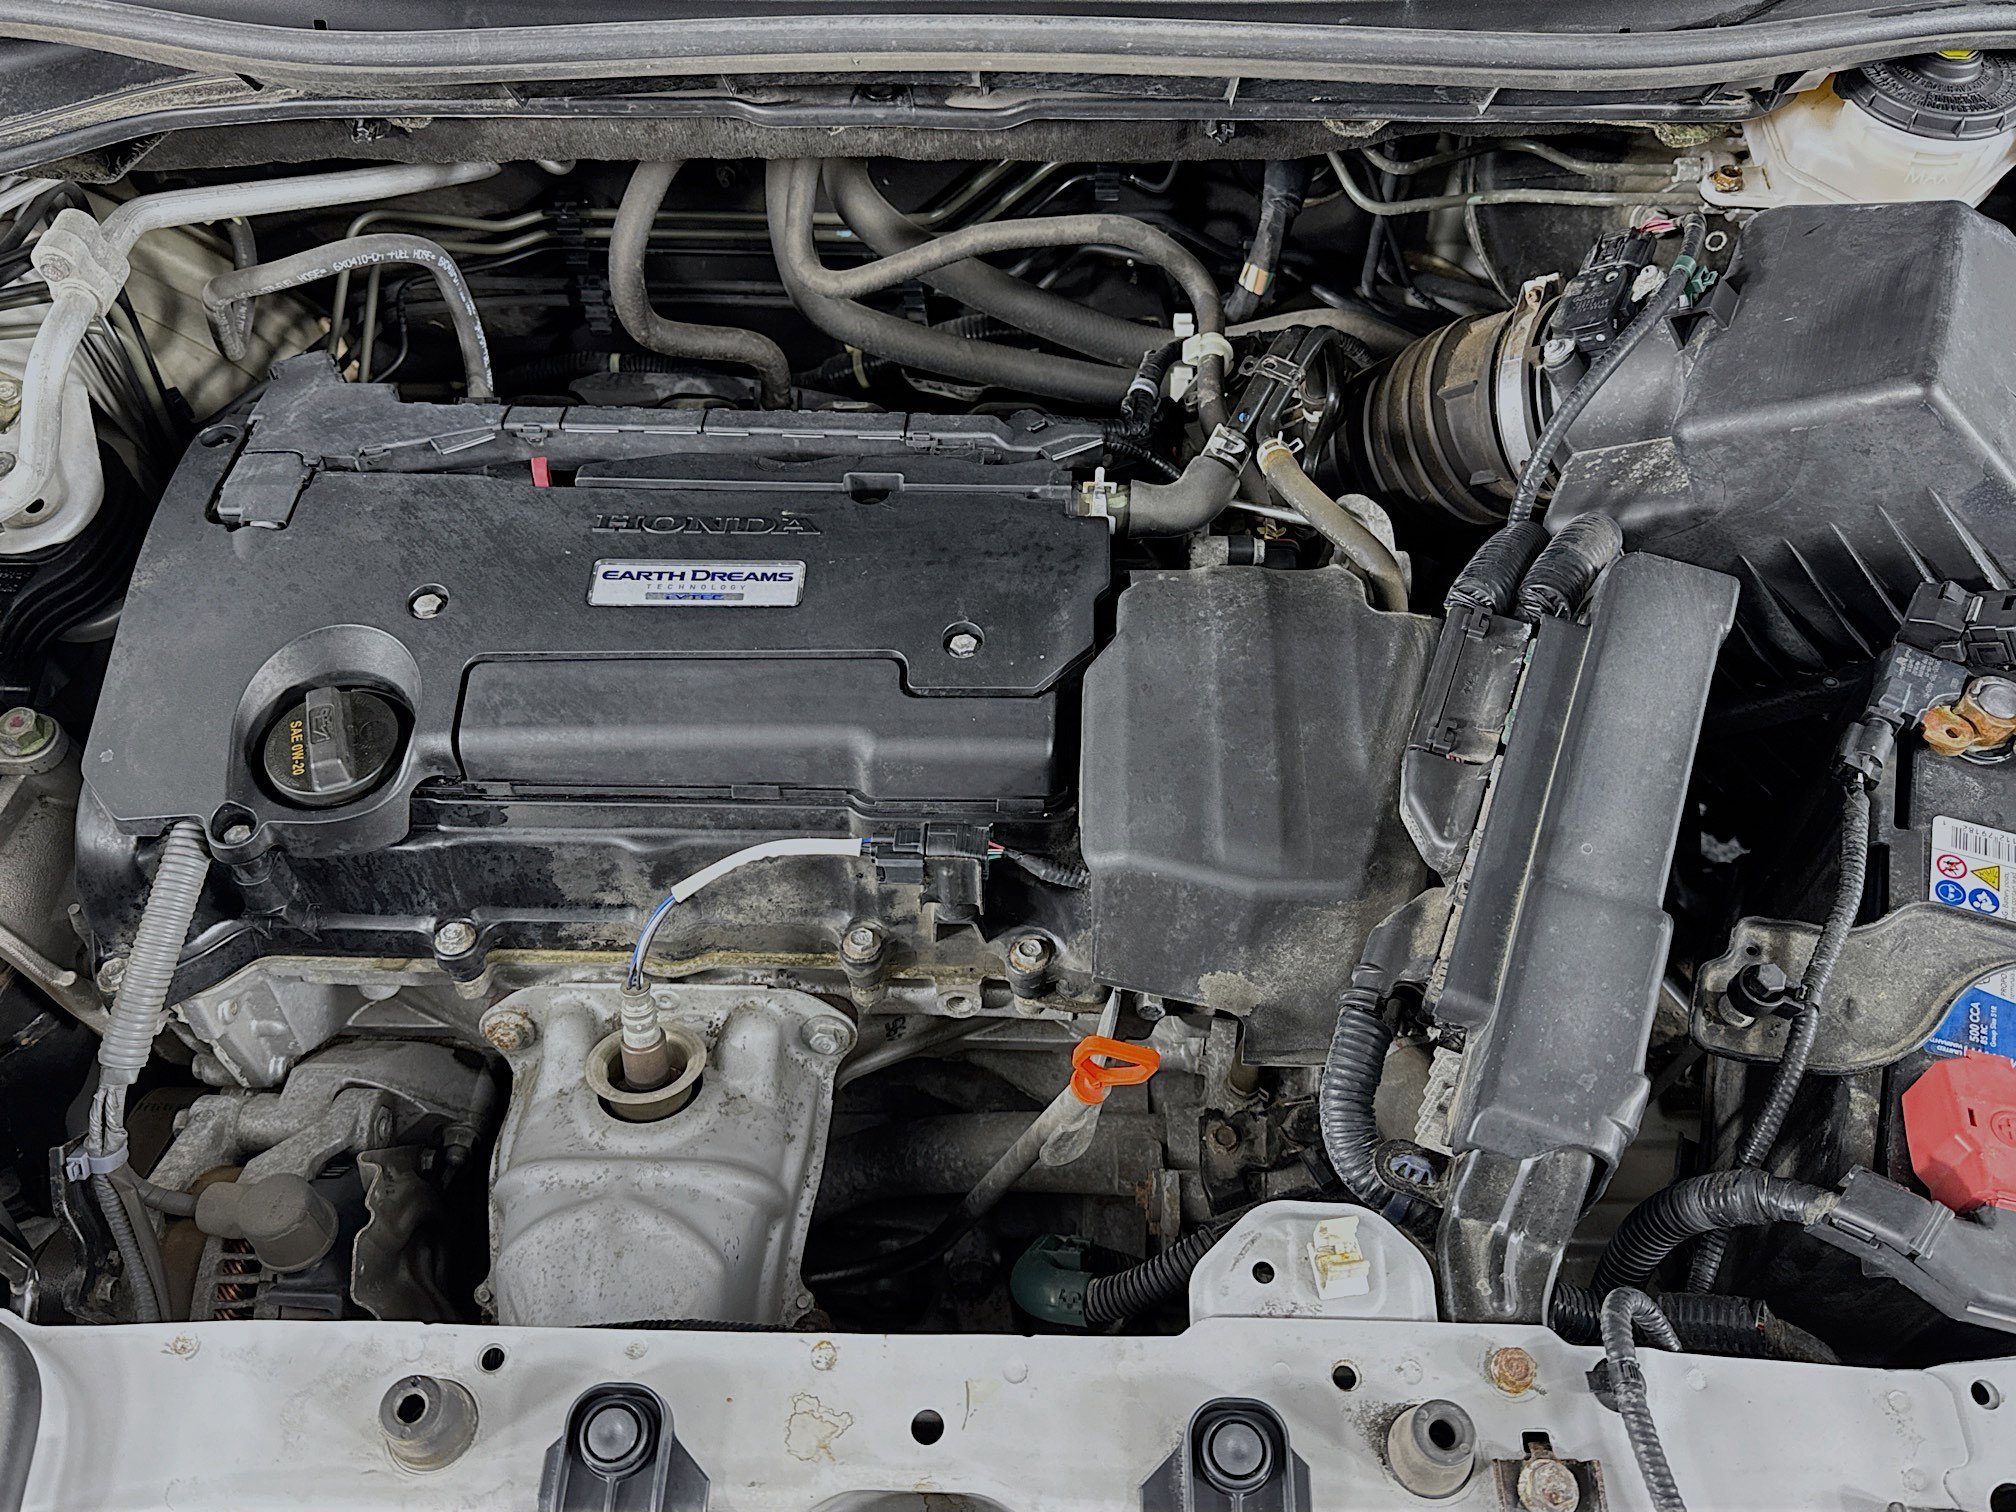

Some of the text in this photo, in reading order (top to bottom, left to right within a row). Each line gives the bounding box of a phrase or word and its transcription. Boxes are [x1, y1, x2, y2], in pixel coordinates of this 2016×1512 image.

[592, 514, 821, 536] HONDA
[602, 569, 794, 582] EARTH DREAMS
[646, 583, 746, 591] TECHNOLOGY
[290, 720, 305, 776] SAE 0W-20
[1968, 1002, 1981, 1043] 500 CCA
[1989, 1029, 1998, 1048] Group
